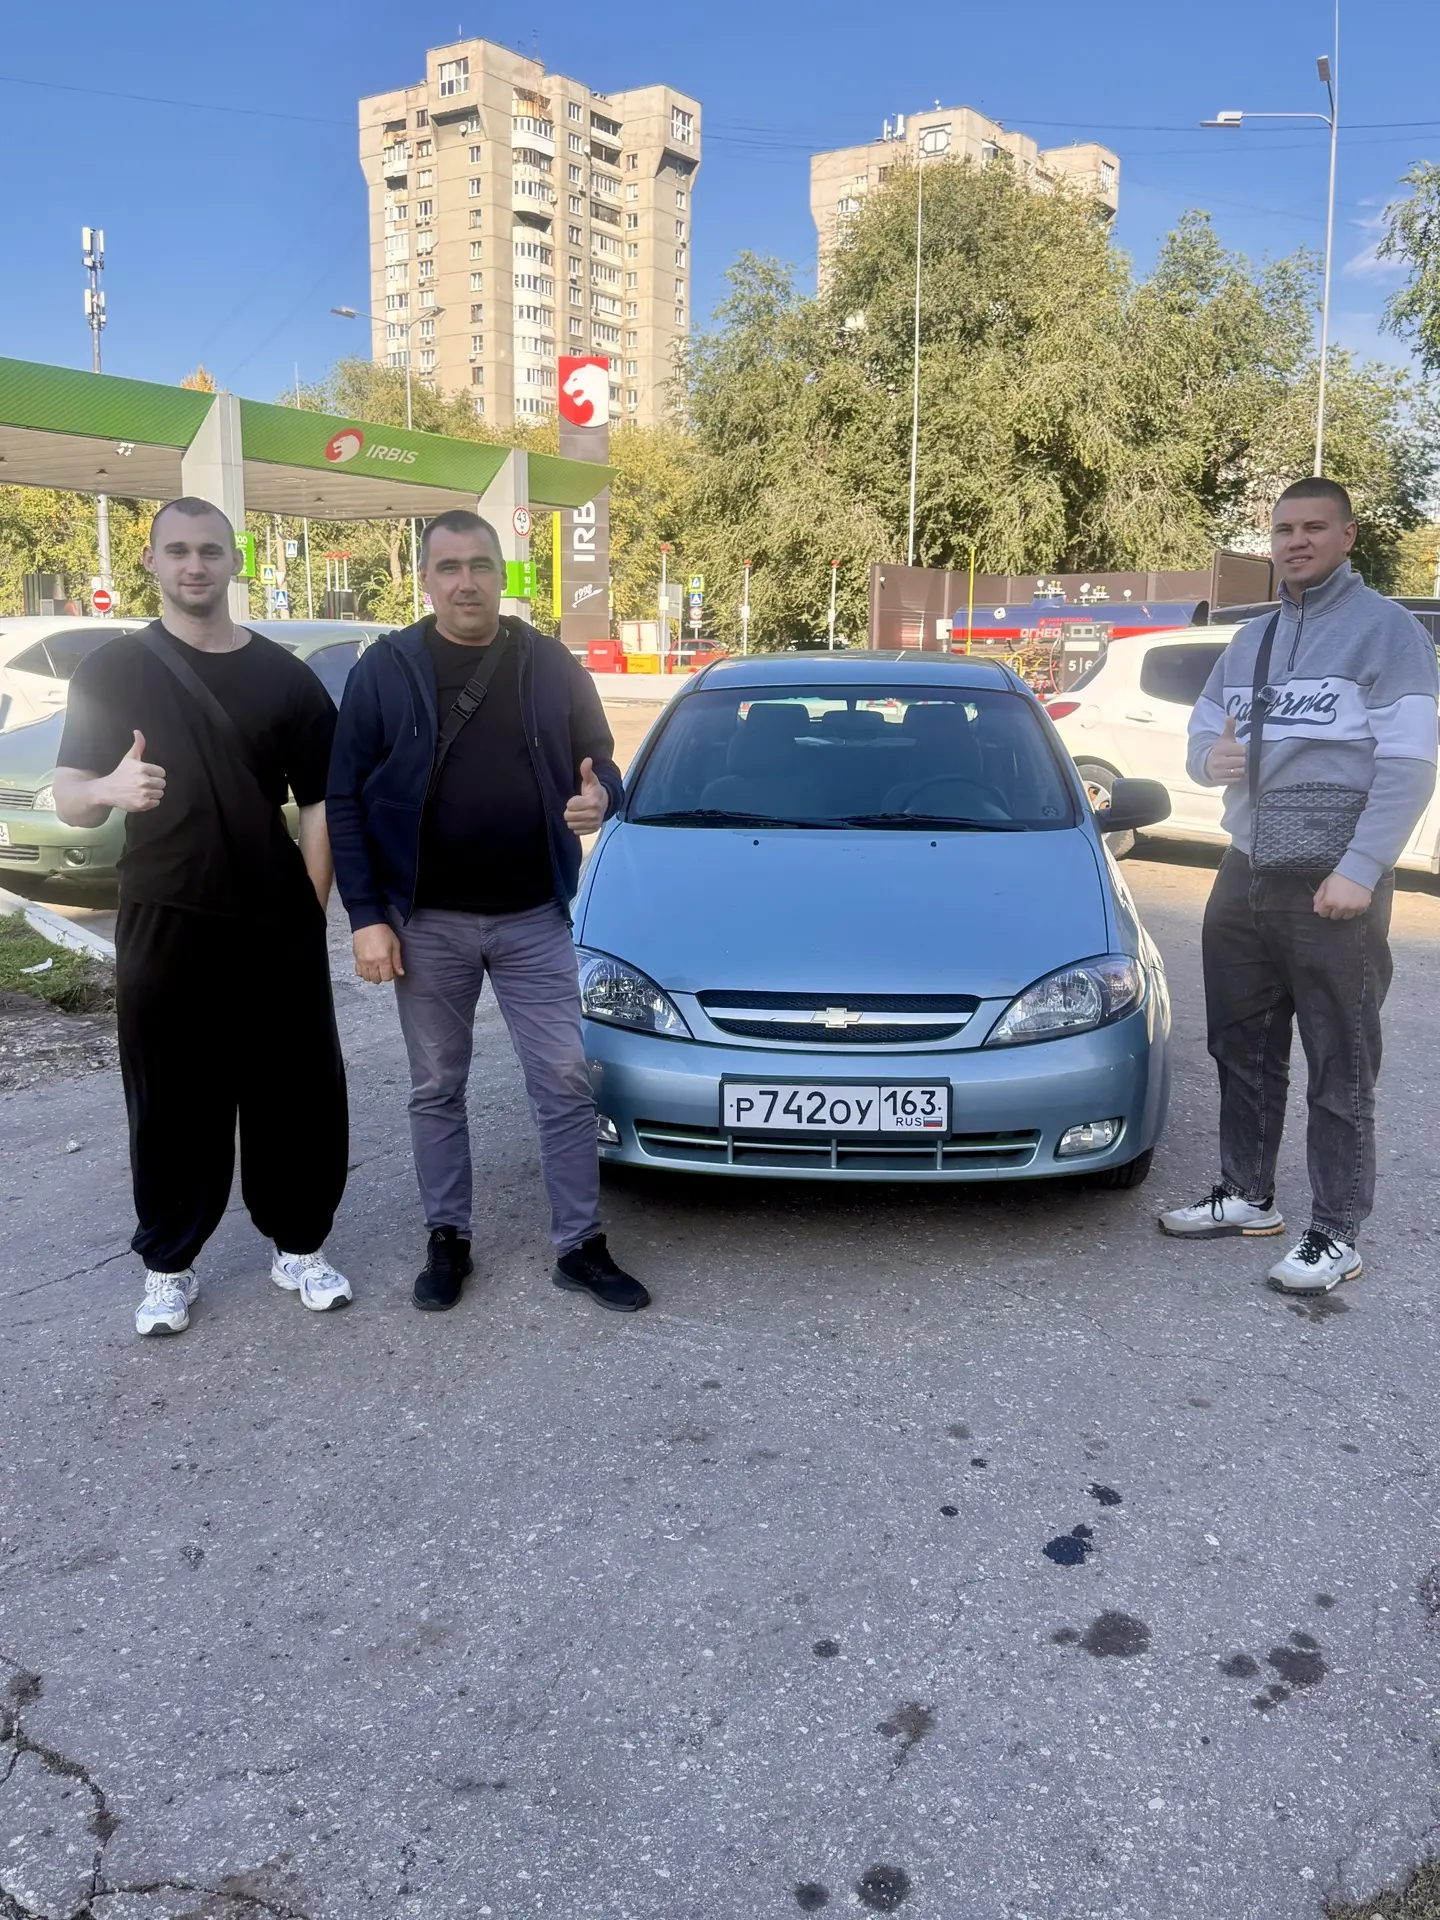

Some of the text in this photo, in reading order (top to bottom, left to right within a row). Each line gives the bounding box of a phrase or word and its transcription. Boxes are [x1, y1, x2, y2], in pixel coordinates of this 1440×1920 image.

[366, 444, 419, 464] IRBIS
[573, 500, 595, 561] IRB
[883, 1090, 936, 1116] 163
[895, 1117, 922, 1127] RUS
